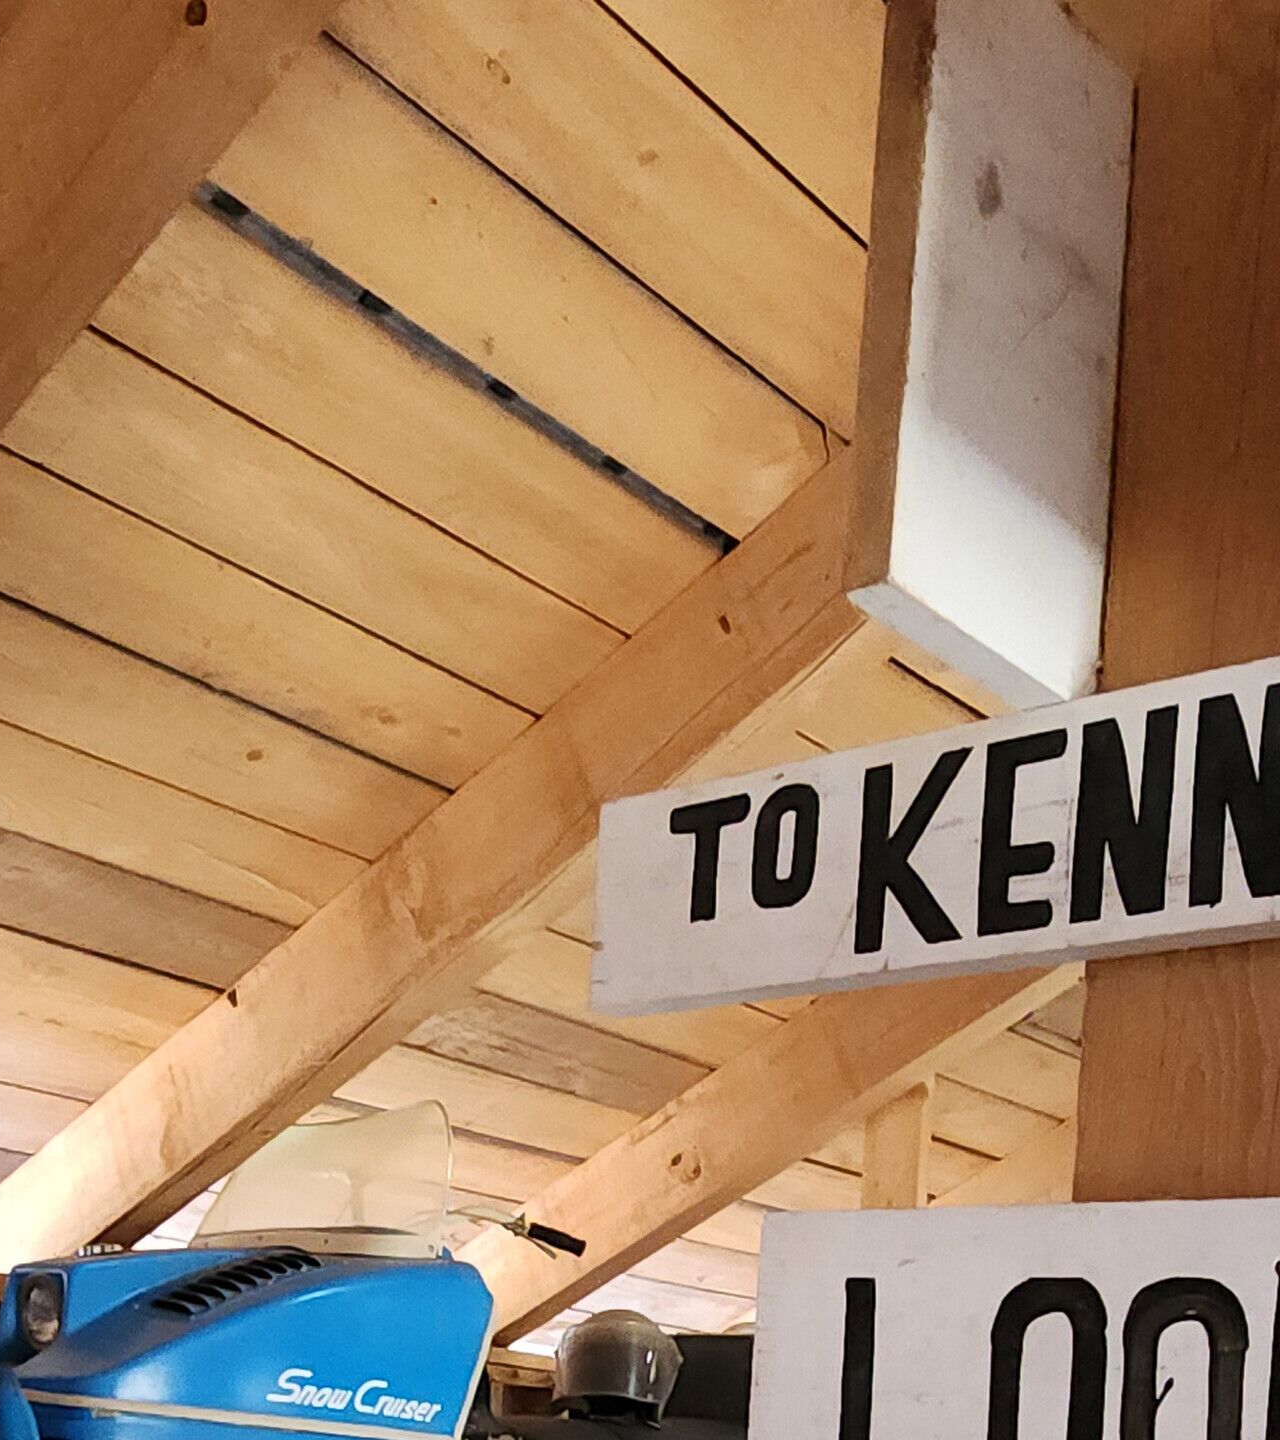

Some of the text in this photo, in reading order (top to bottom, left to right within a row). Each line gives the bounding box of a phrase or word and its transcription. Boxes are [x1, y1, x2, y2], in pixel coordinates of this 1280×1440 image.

[669, 782, 819, 923] TO
[266, 1367, 442, 1423] Snow Cruiser
